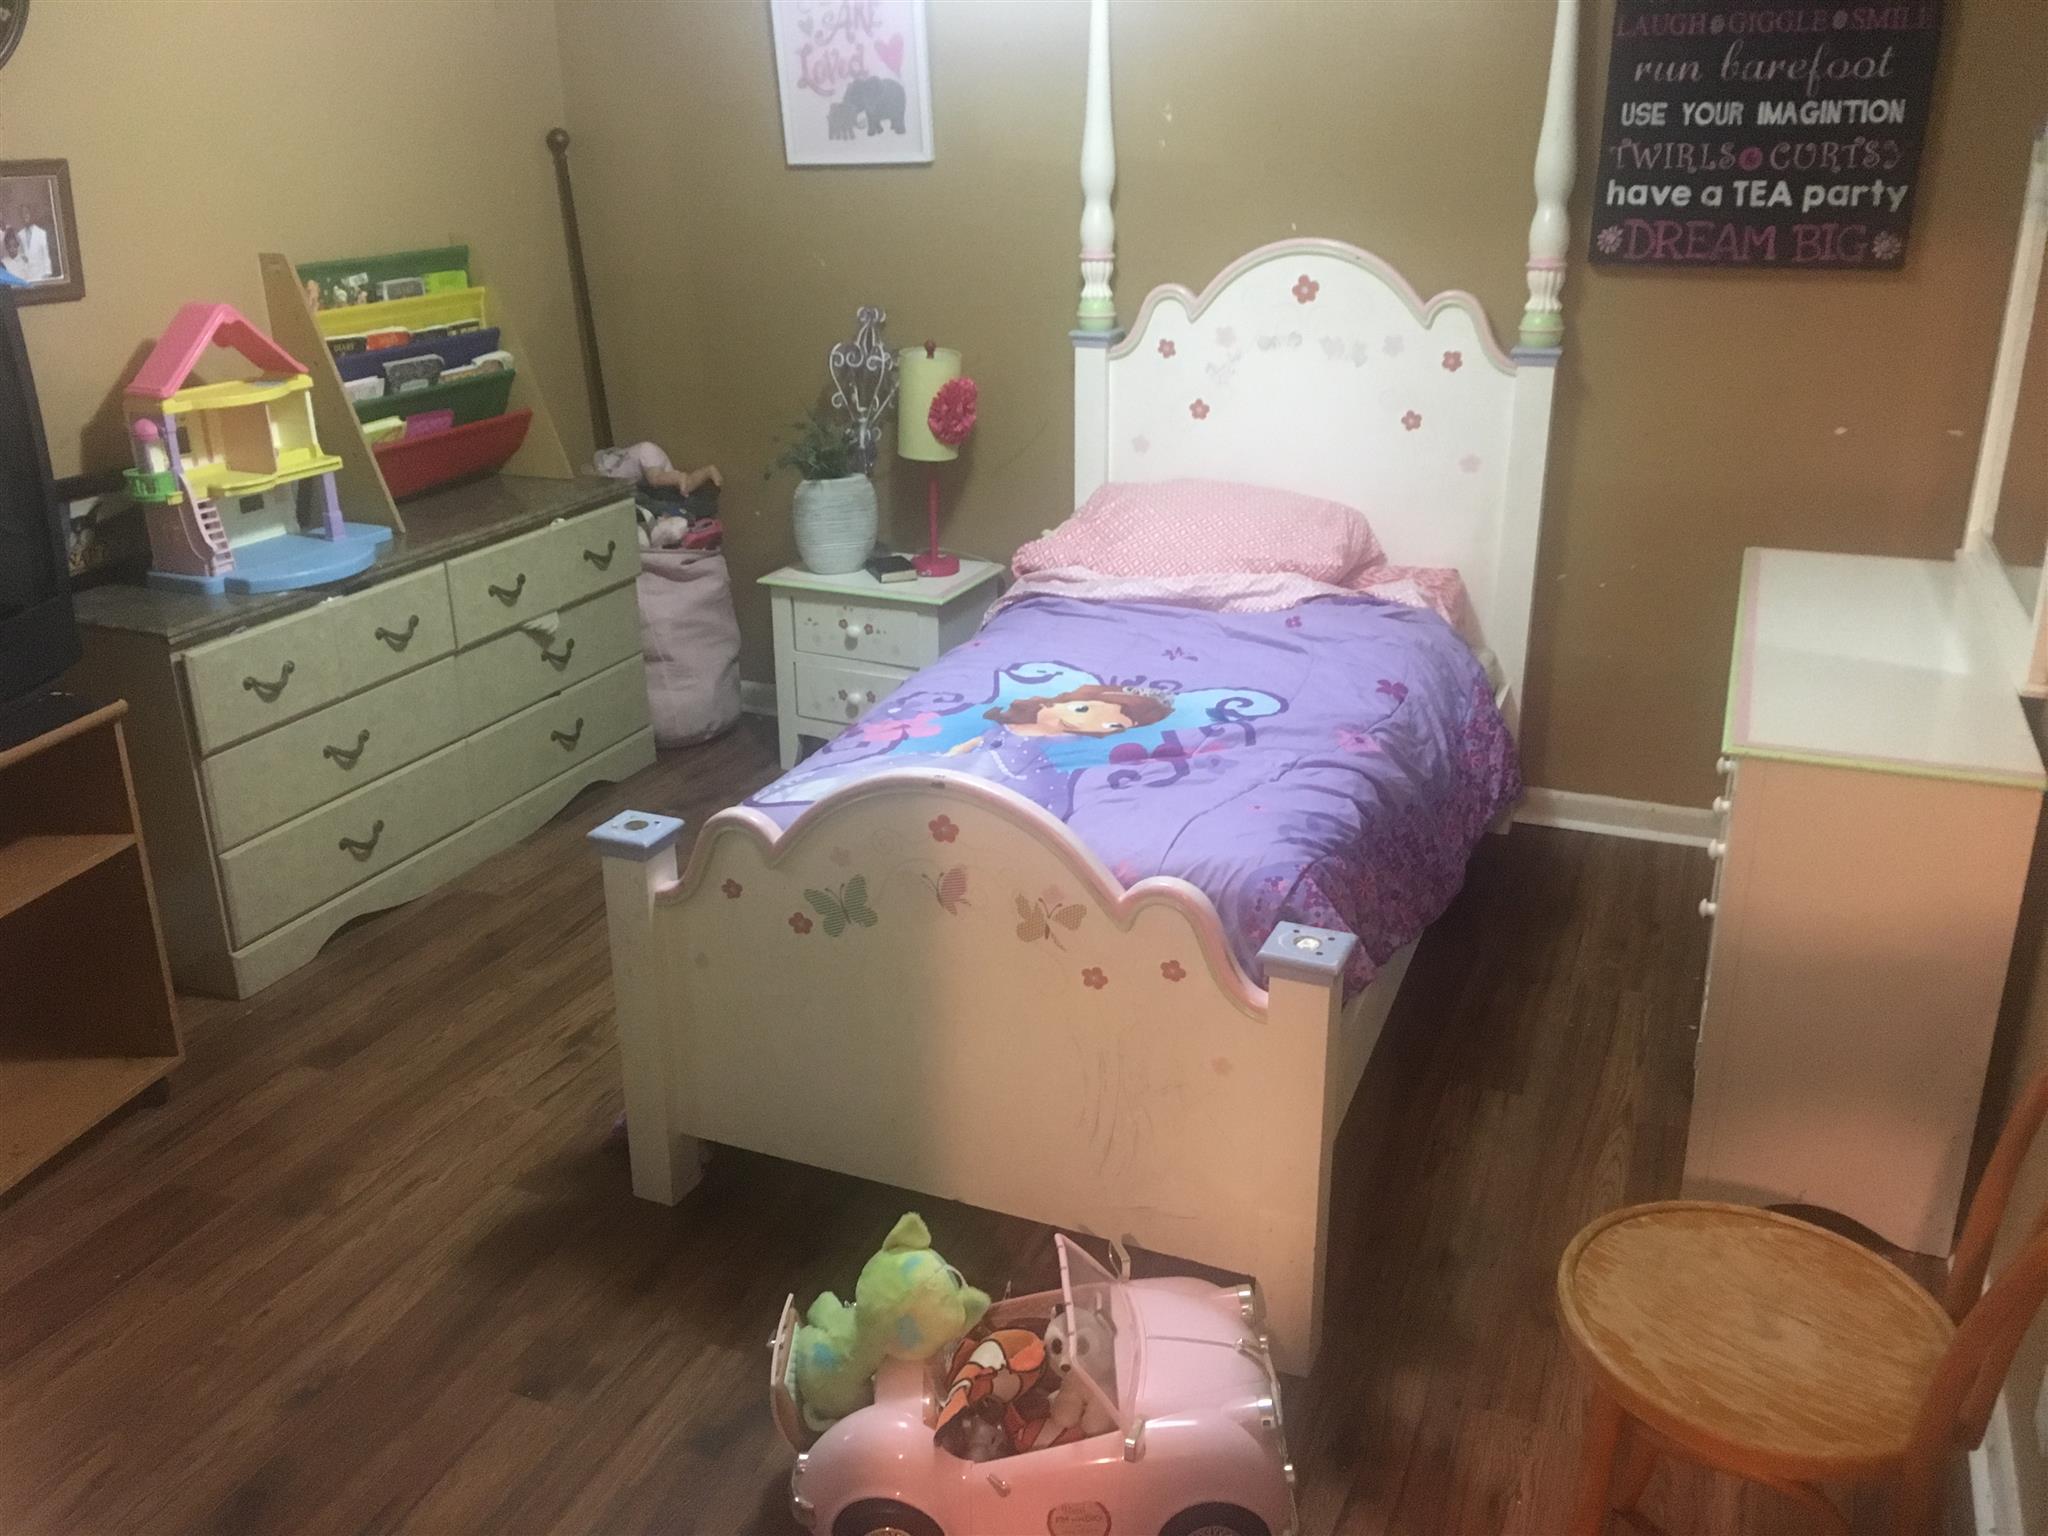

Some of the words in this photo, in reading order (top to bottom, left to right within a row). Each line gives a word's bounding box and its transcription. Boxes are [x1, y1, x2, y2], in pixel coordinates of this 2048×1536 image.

[1616, 13, 1708, 37] LAUGH
[1728, 9, 1828, 34] GIGGLE
[1634, 59, 1703, 83] run
[1720, 38, 1894, 97] barefoot
[1621, 101, 1667, 127] USE
[1682, 101, 1744, 126] YOUR
[1756, 98, 1906, 126] IMAGINTION
[1611, 137, 1736, 174] TWIRLS
[1606, 179, 1693, 208] have
[1700, 187, 1723, 208] a
[1733, 180, 1793, 208] TEA
[1801, 179, 1909, 214] party
[1623, 218, 1776, 262] DREAM
[1792, 222, 1868, 263] BIG
